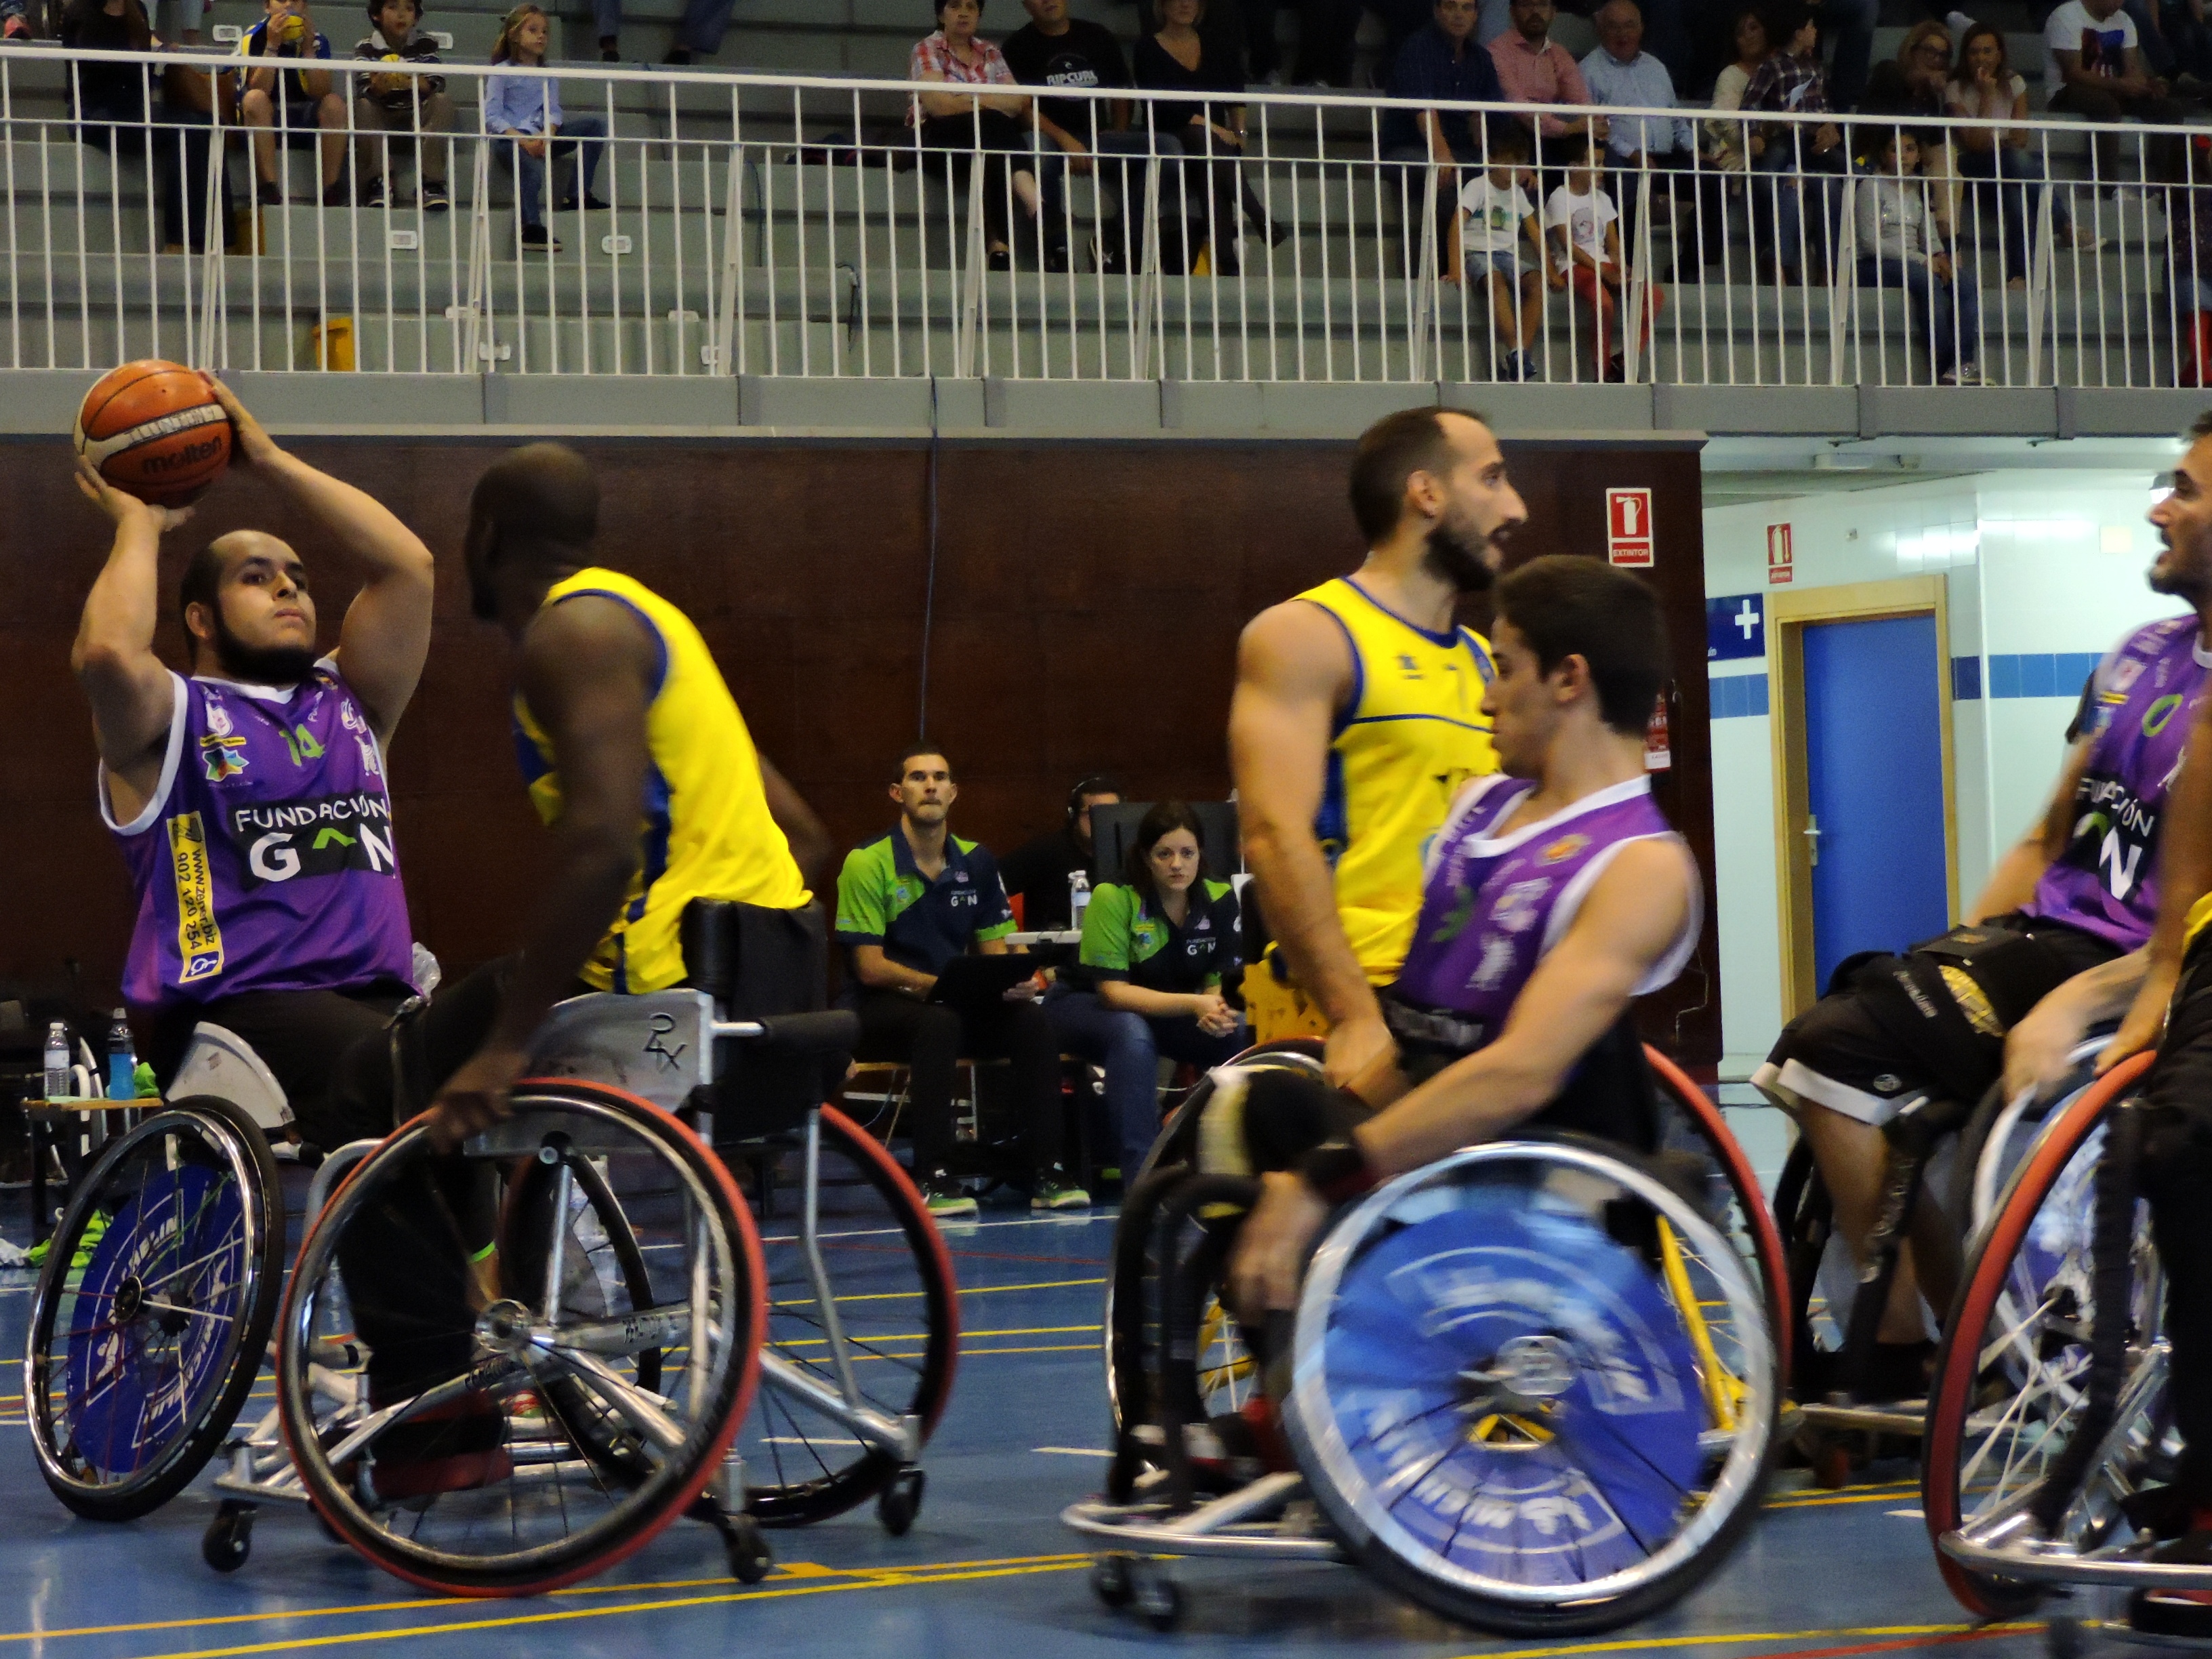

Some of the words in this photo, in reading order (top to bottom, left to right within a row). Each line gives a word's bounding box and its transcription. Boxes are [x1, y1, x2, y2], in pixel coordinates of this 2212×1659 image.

[142, 435, 222, 473] molten
[279, 723, 326, 767] 14
[178, 851, 191, 883] 902
[181, 888, 198, 918] 120
[192, 848, 216, 946] www.zener.biz
[185, 920, 203, 950] 254
